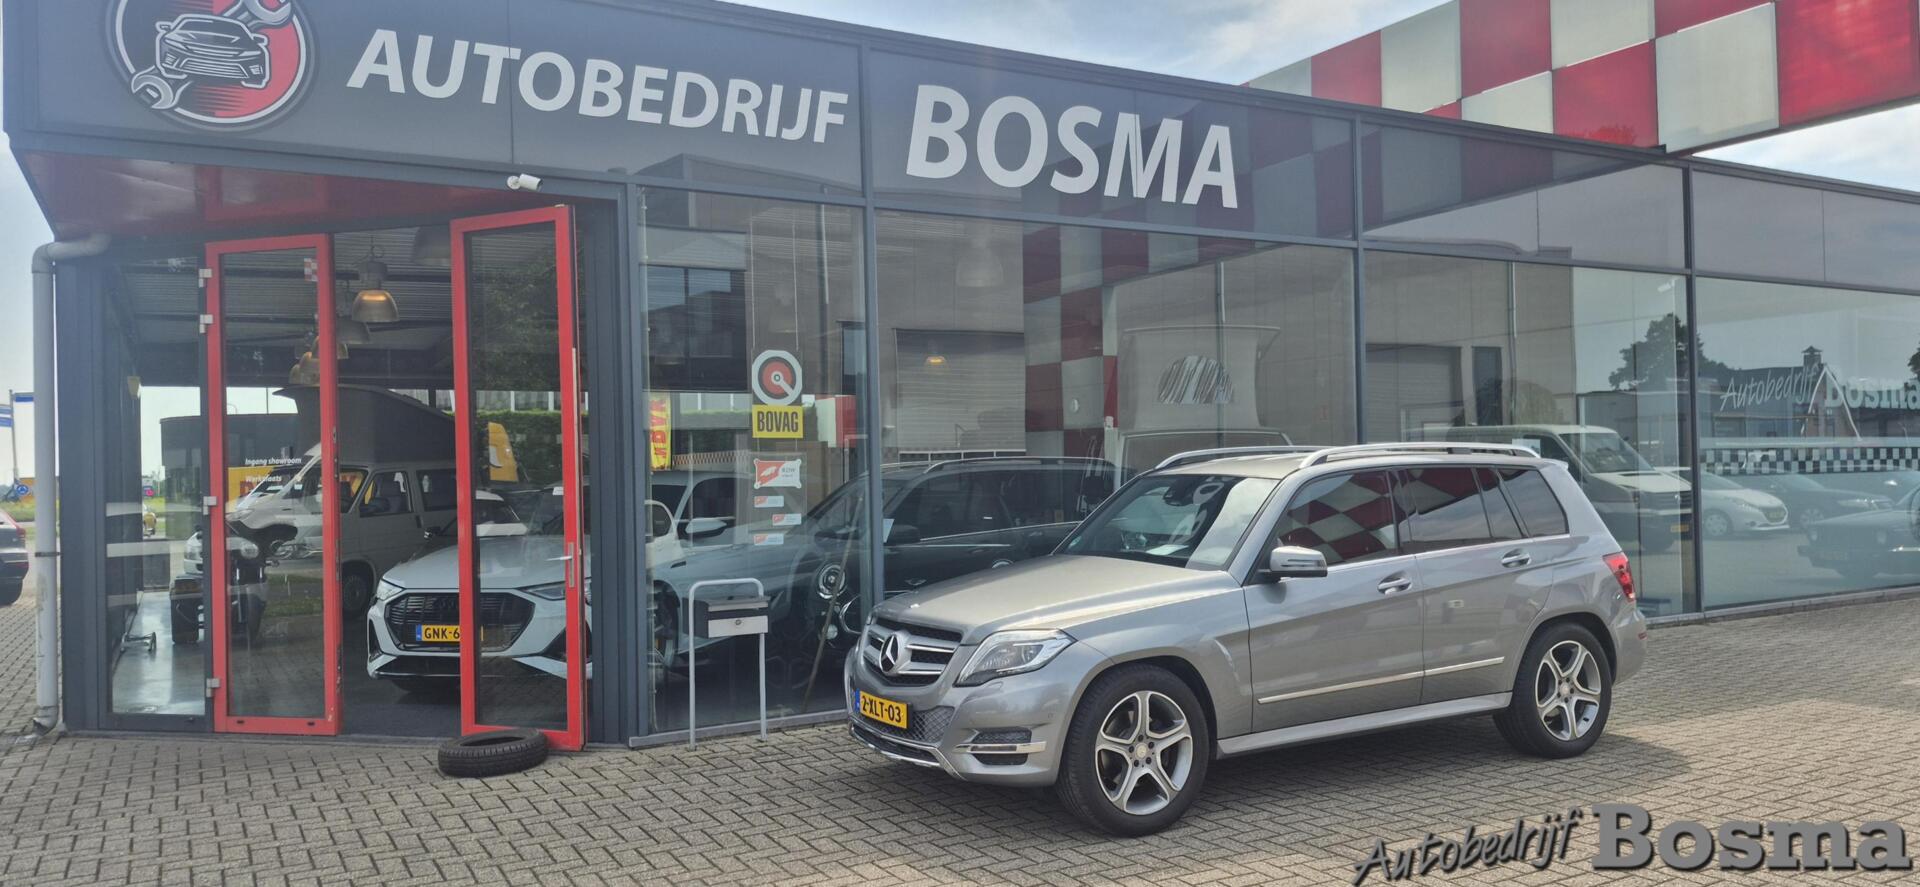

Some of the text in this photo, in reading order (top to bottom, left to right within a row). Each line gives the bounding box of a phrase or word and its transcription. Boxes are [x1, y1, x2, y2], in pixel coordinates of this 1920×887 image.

[346, 28, 1238, 208] AUTOBEDRIJF BOSMA
[1720, 363, 1820, 412] Autobedrijf
[757, 410, 799, 432] BOVAG
[245, 457, 302, 467] Ingang showroom
[424, 627, 460, 639] GNK-6
[861, 695, 902, 723] 2-XLT-03
